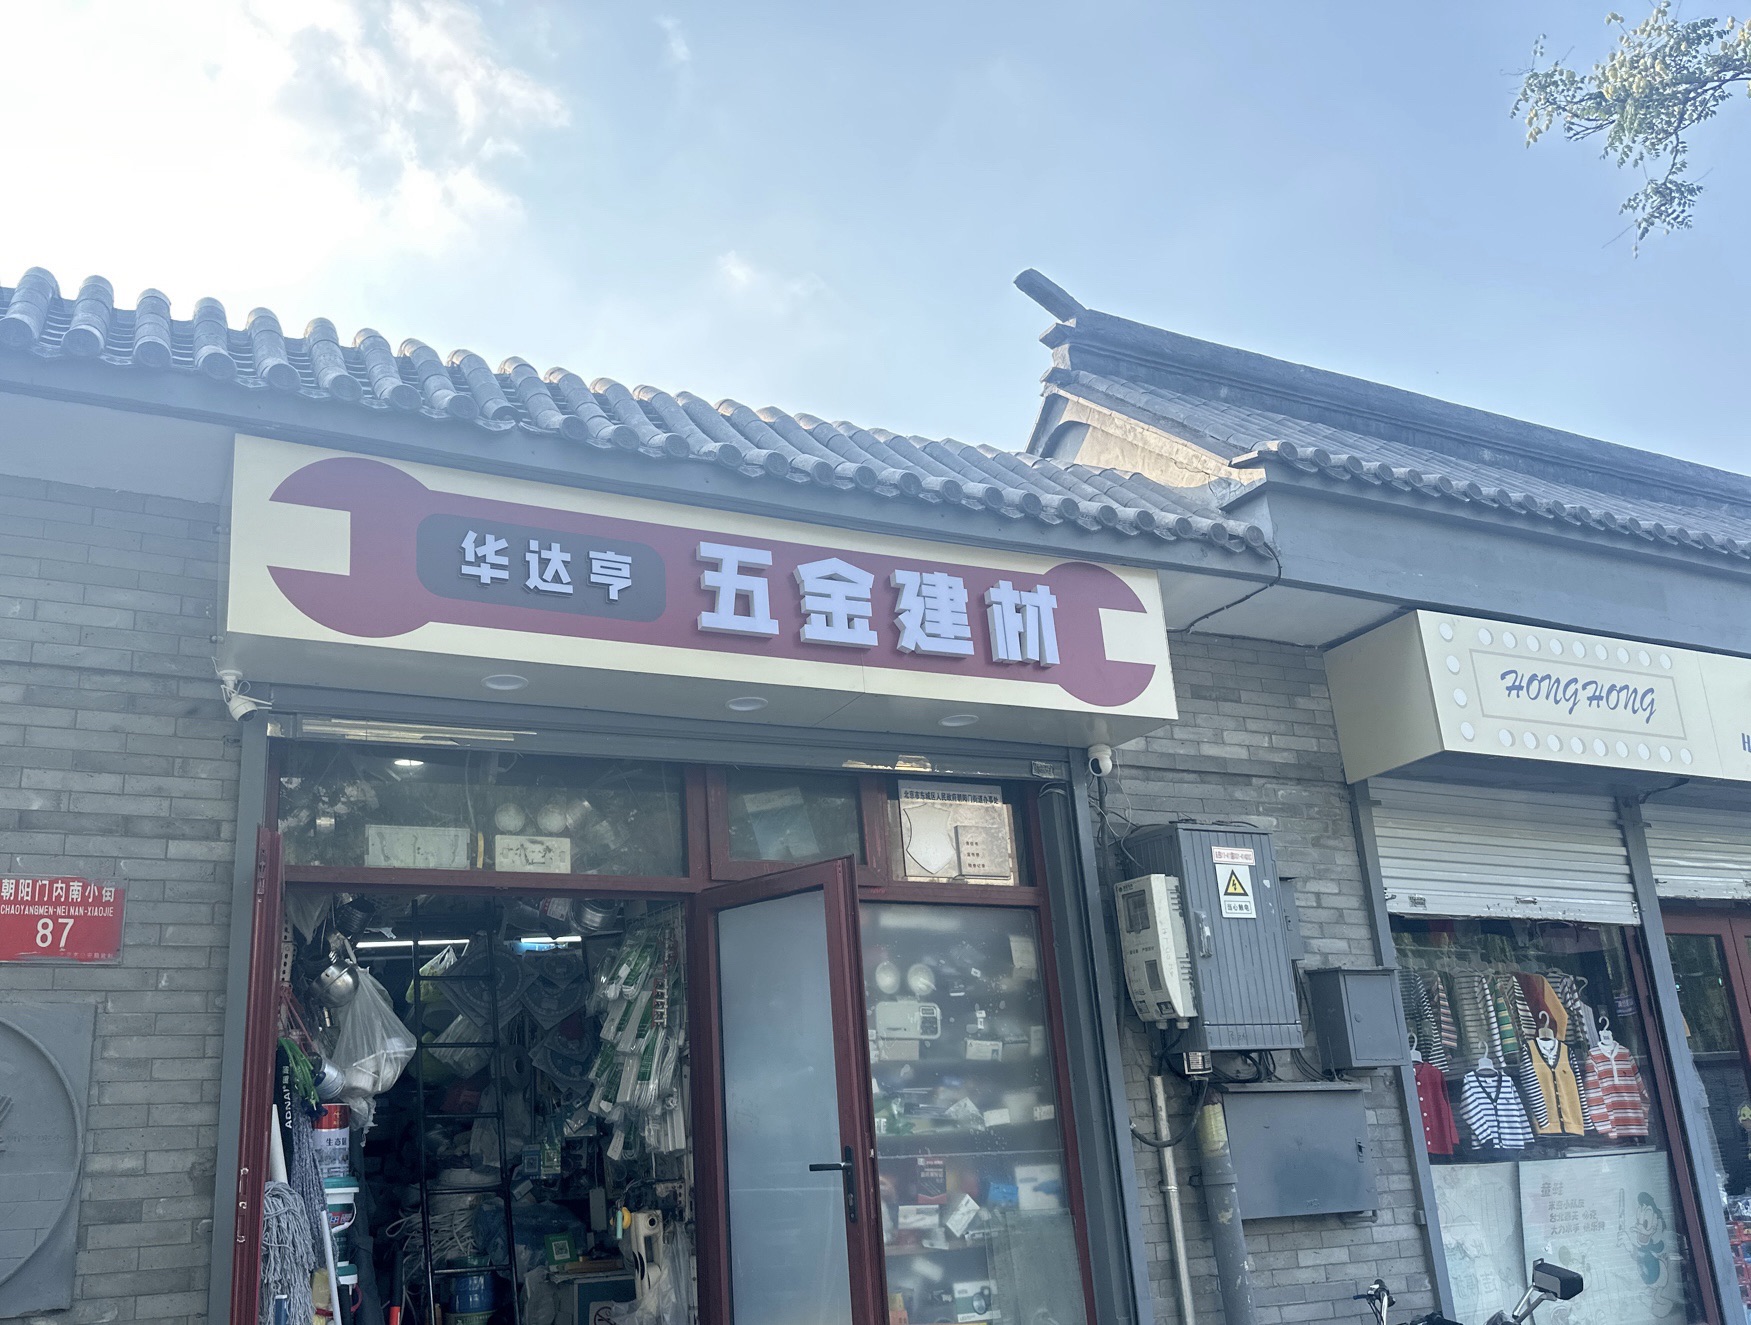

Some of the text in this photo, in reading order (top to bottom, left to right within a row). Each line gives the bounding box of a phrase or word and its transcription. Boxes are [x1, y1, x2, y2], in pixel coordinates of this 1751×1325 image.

[460, 530, 1060, 667] 华达亨 五金建材
[1226, 902, 1251, 912] 当心触电
[35, 917, 75, 948] 87
